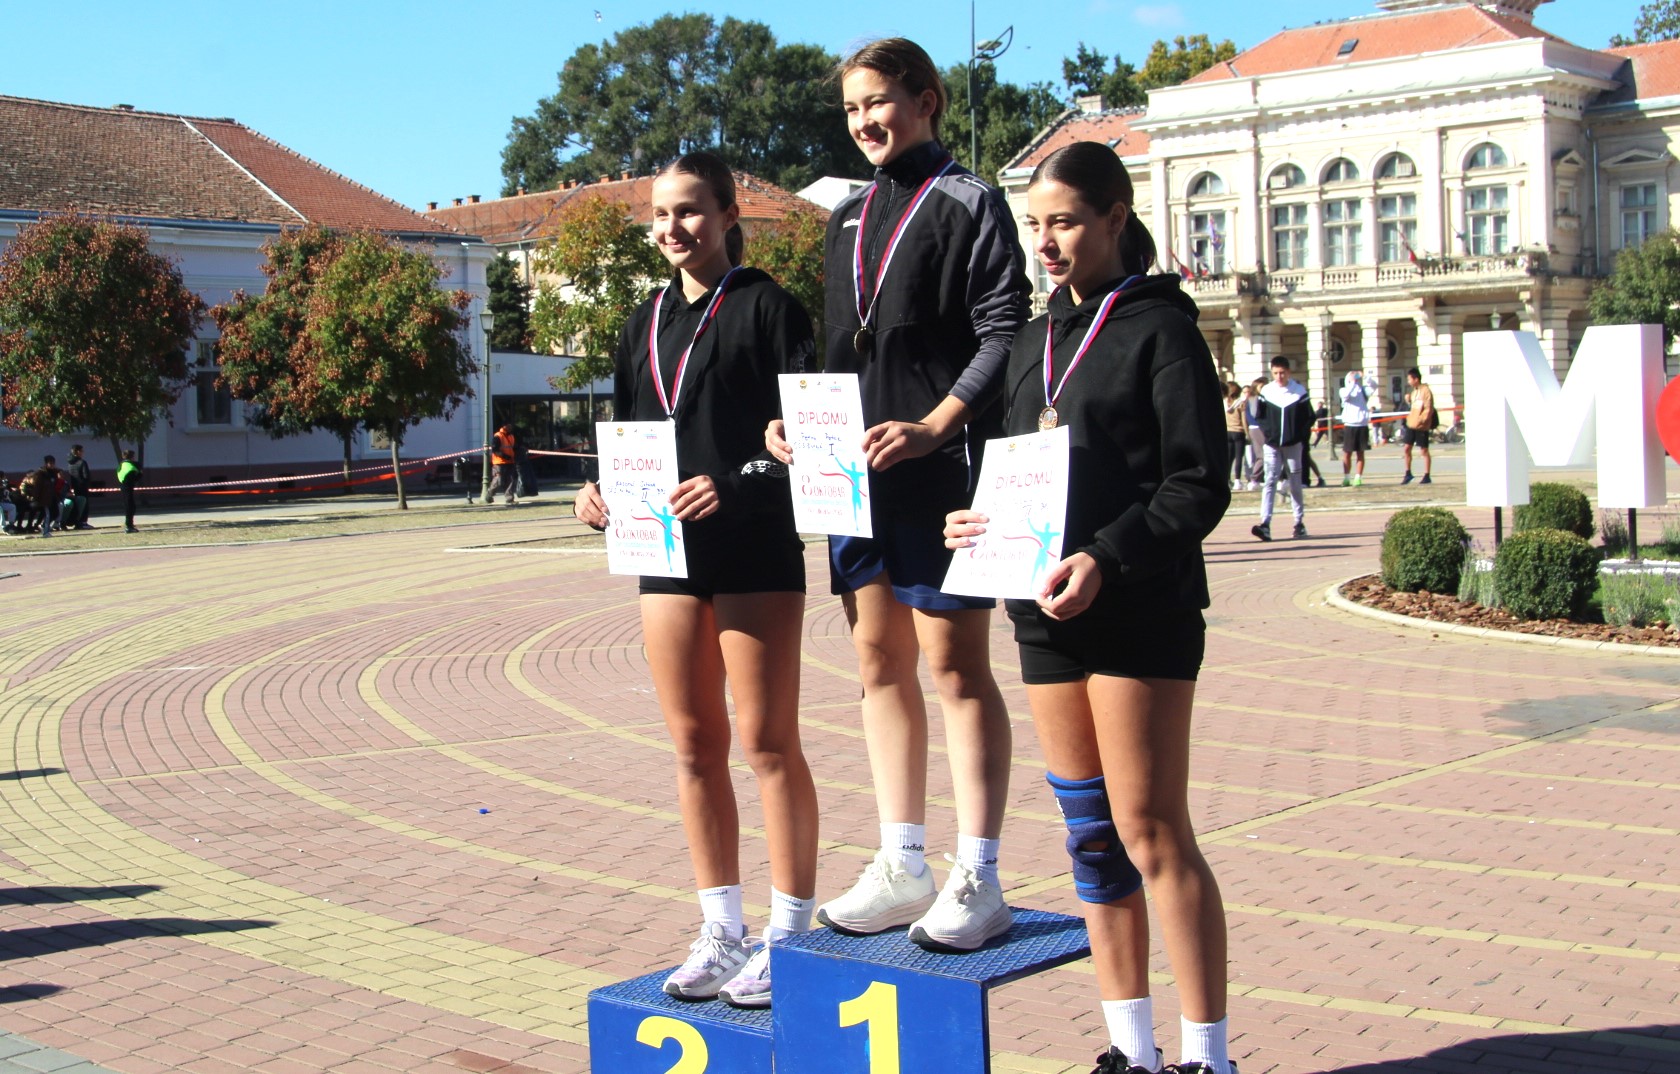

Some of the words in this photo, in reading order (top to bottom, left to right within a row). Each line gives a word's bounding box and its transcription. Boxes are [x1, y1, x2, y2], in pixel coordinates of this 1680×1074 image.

[798, 411, 848, 426] DIPLOMU
[1463, 324, 1667, 508] M
[613, 458, 662, 471] DIPLOMU
[995, 470, 1053, 490] DIPLOMU
[635, 1015, 709, 1074] 2
[839, 980, 901, 1074] 1
